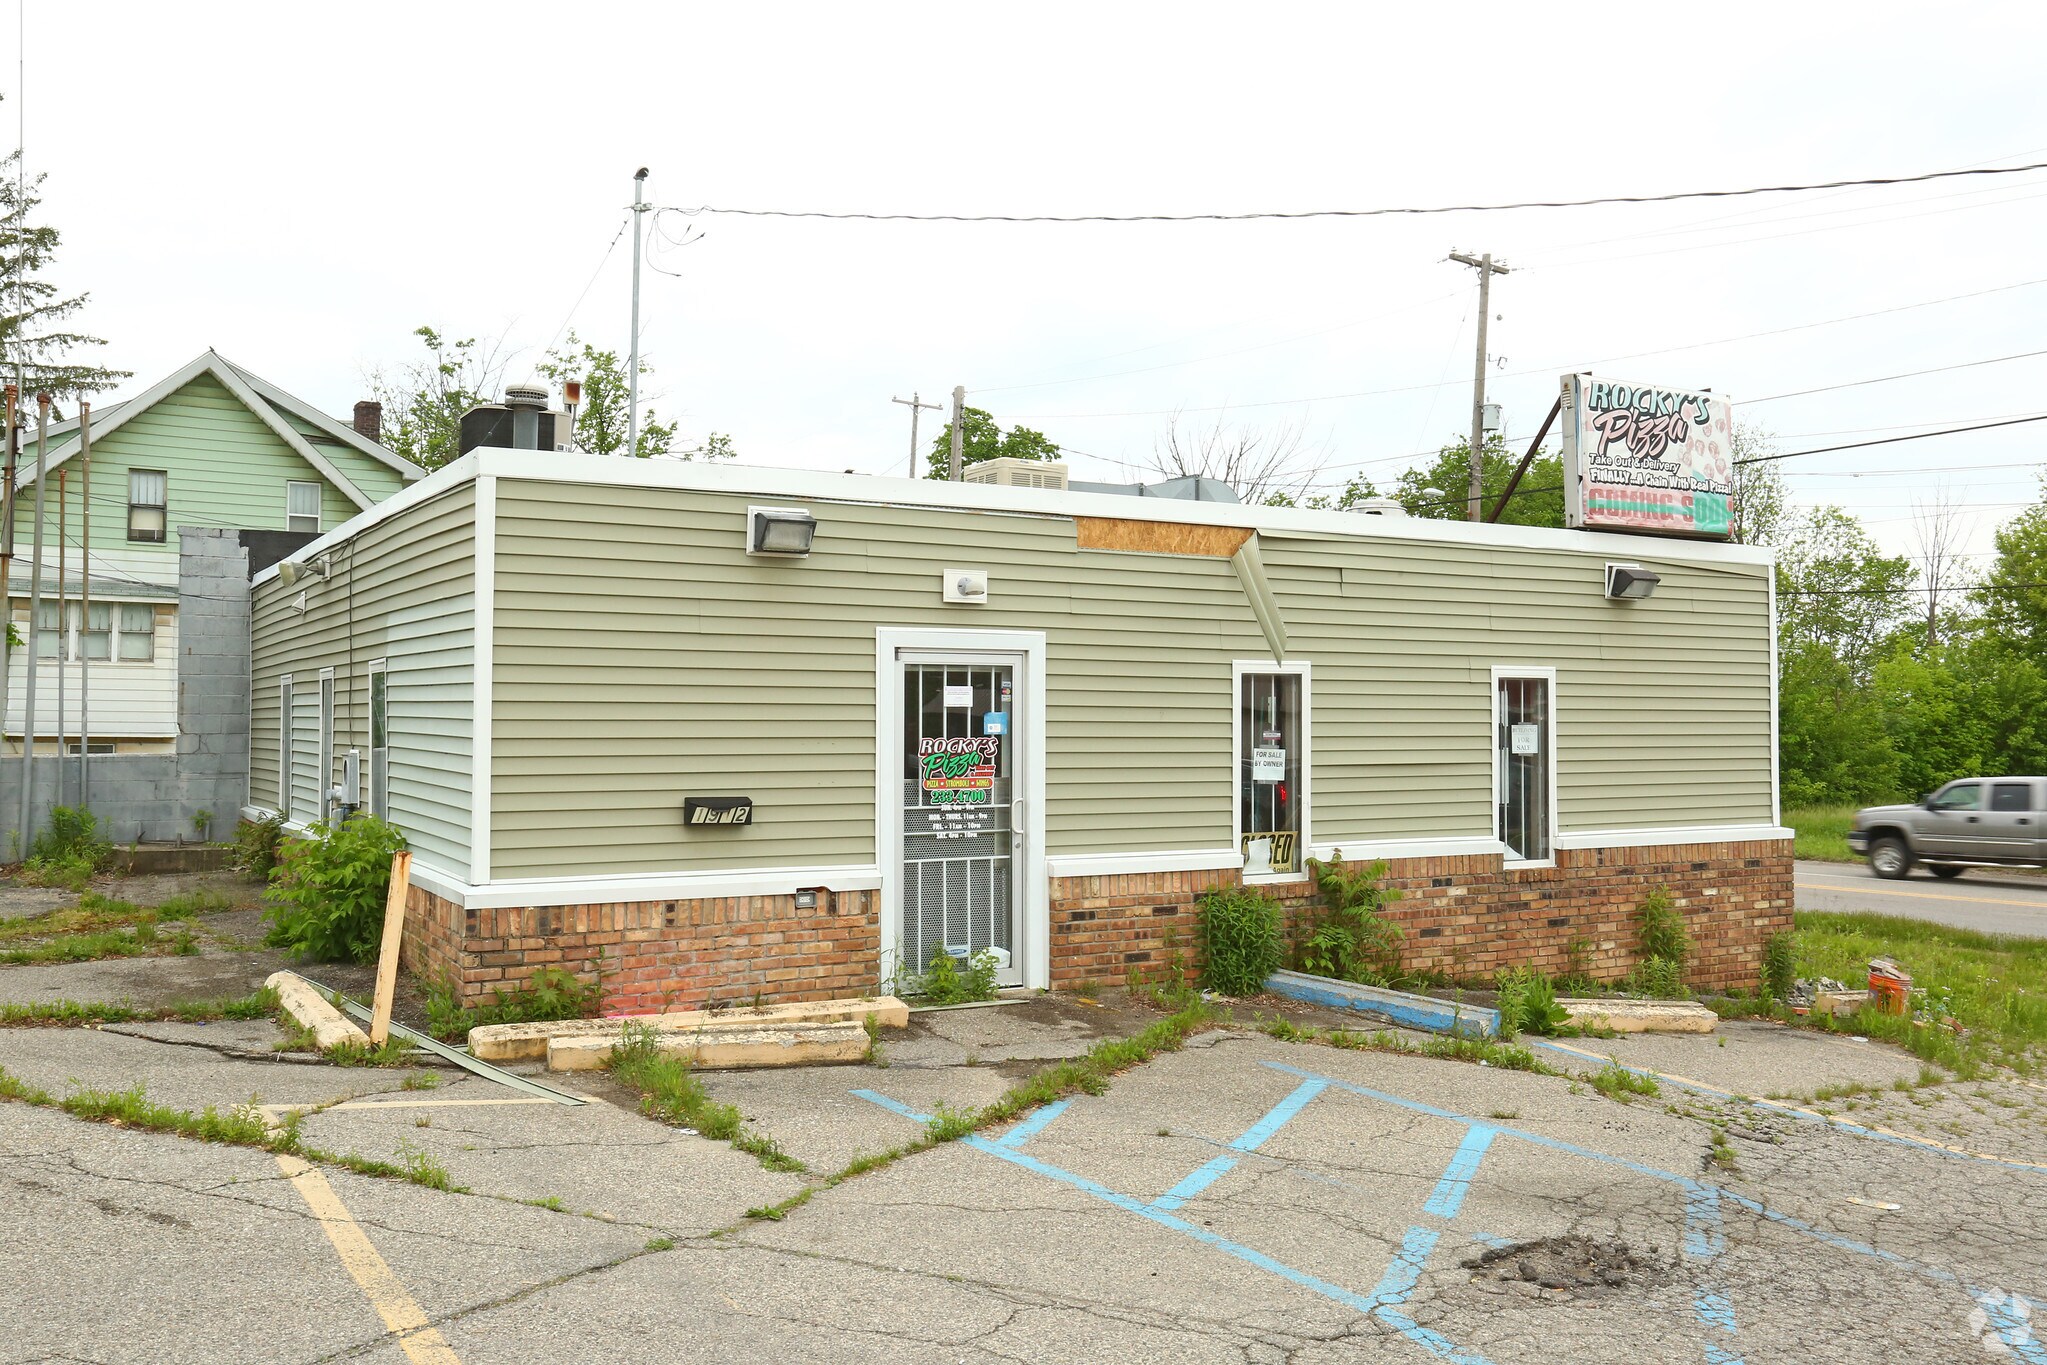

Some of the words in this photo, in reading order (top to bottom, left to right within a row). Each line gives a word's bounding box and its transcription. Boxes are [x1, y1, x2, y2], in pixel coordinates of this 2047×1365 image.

[1588, 381, 1710, 425] ROCKY'S
[1593, 408, 1689, 459] Pizza
[1589, 453, 1612, 465] Take
[1614, 455, 1632, 467] Out
[1633, 457, 1641, 468] &
[1642, 457, 1680, 473] Delivery
[1645, 473, 1668, 488] Chain
[1669, 475, 1689, 490] With
[1690, 478, 1709, 492] Real
[1710, 480, 1733, 495] Pizza!
[1589, 489, 1674, 520] COMING
[919, 738, 998, 757] ROCKY'S
[922, 751, 981, 779] Pizza
[1262, 760, 1284, 768] OWNER
